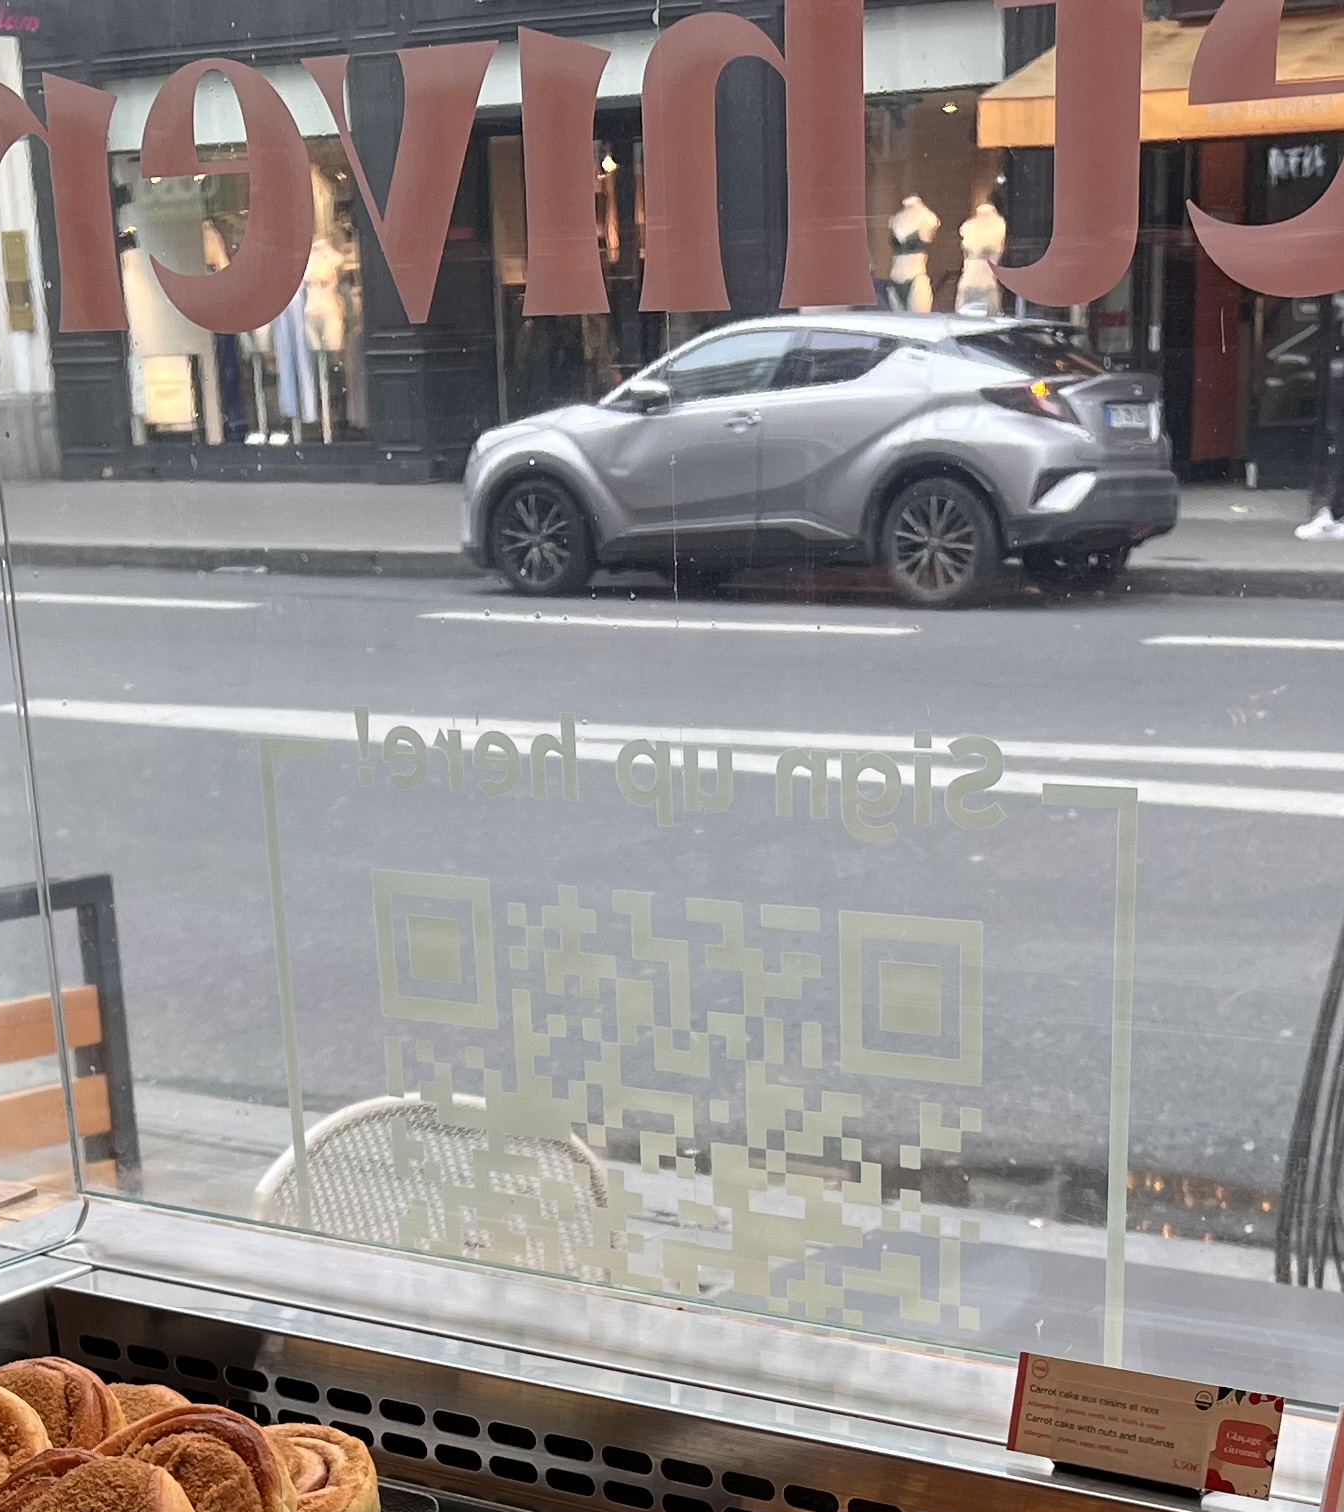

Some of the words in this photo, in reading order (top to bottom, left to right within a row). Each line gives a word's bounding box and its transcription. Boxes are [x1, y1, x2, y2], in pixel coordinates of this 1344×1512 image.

[1030, 1384, 1056, 1396] Carrot
[1059, 1390, 1079, 1401] cake
[1025, 1413, 1053, 1425] Carrot
[1055, 1419, 1075, 1430] cake
[1077, 1423, 1096, 1434] with
[1098, 1427, 1117, 1438] nuts
[1119, 1431, 1136, 1442] and
